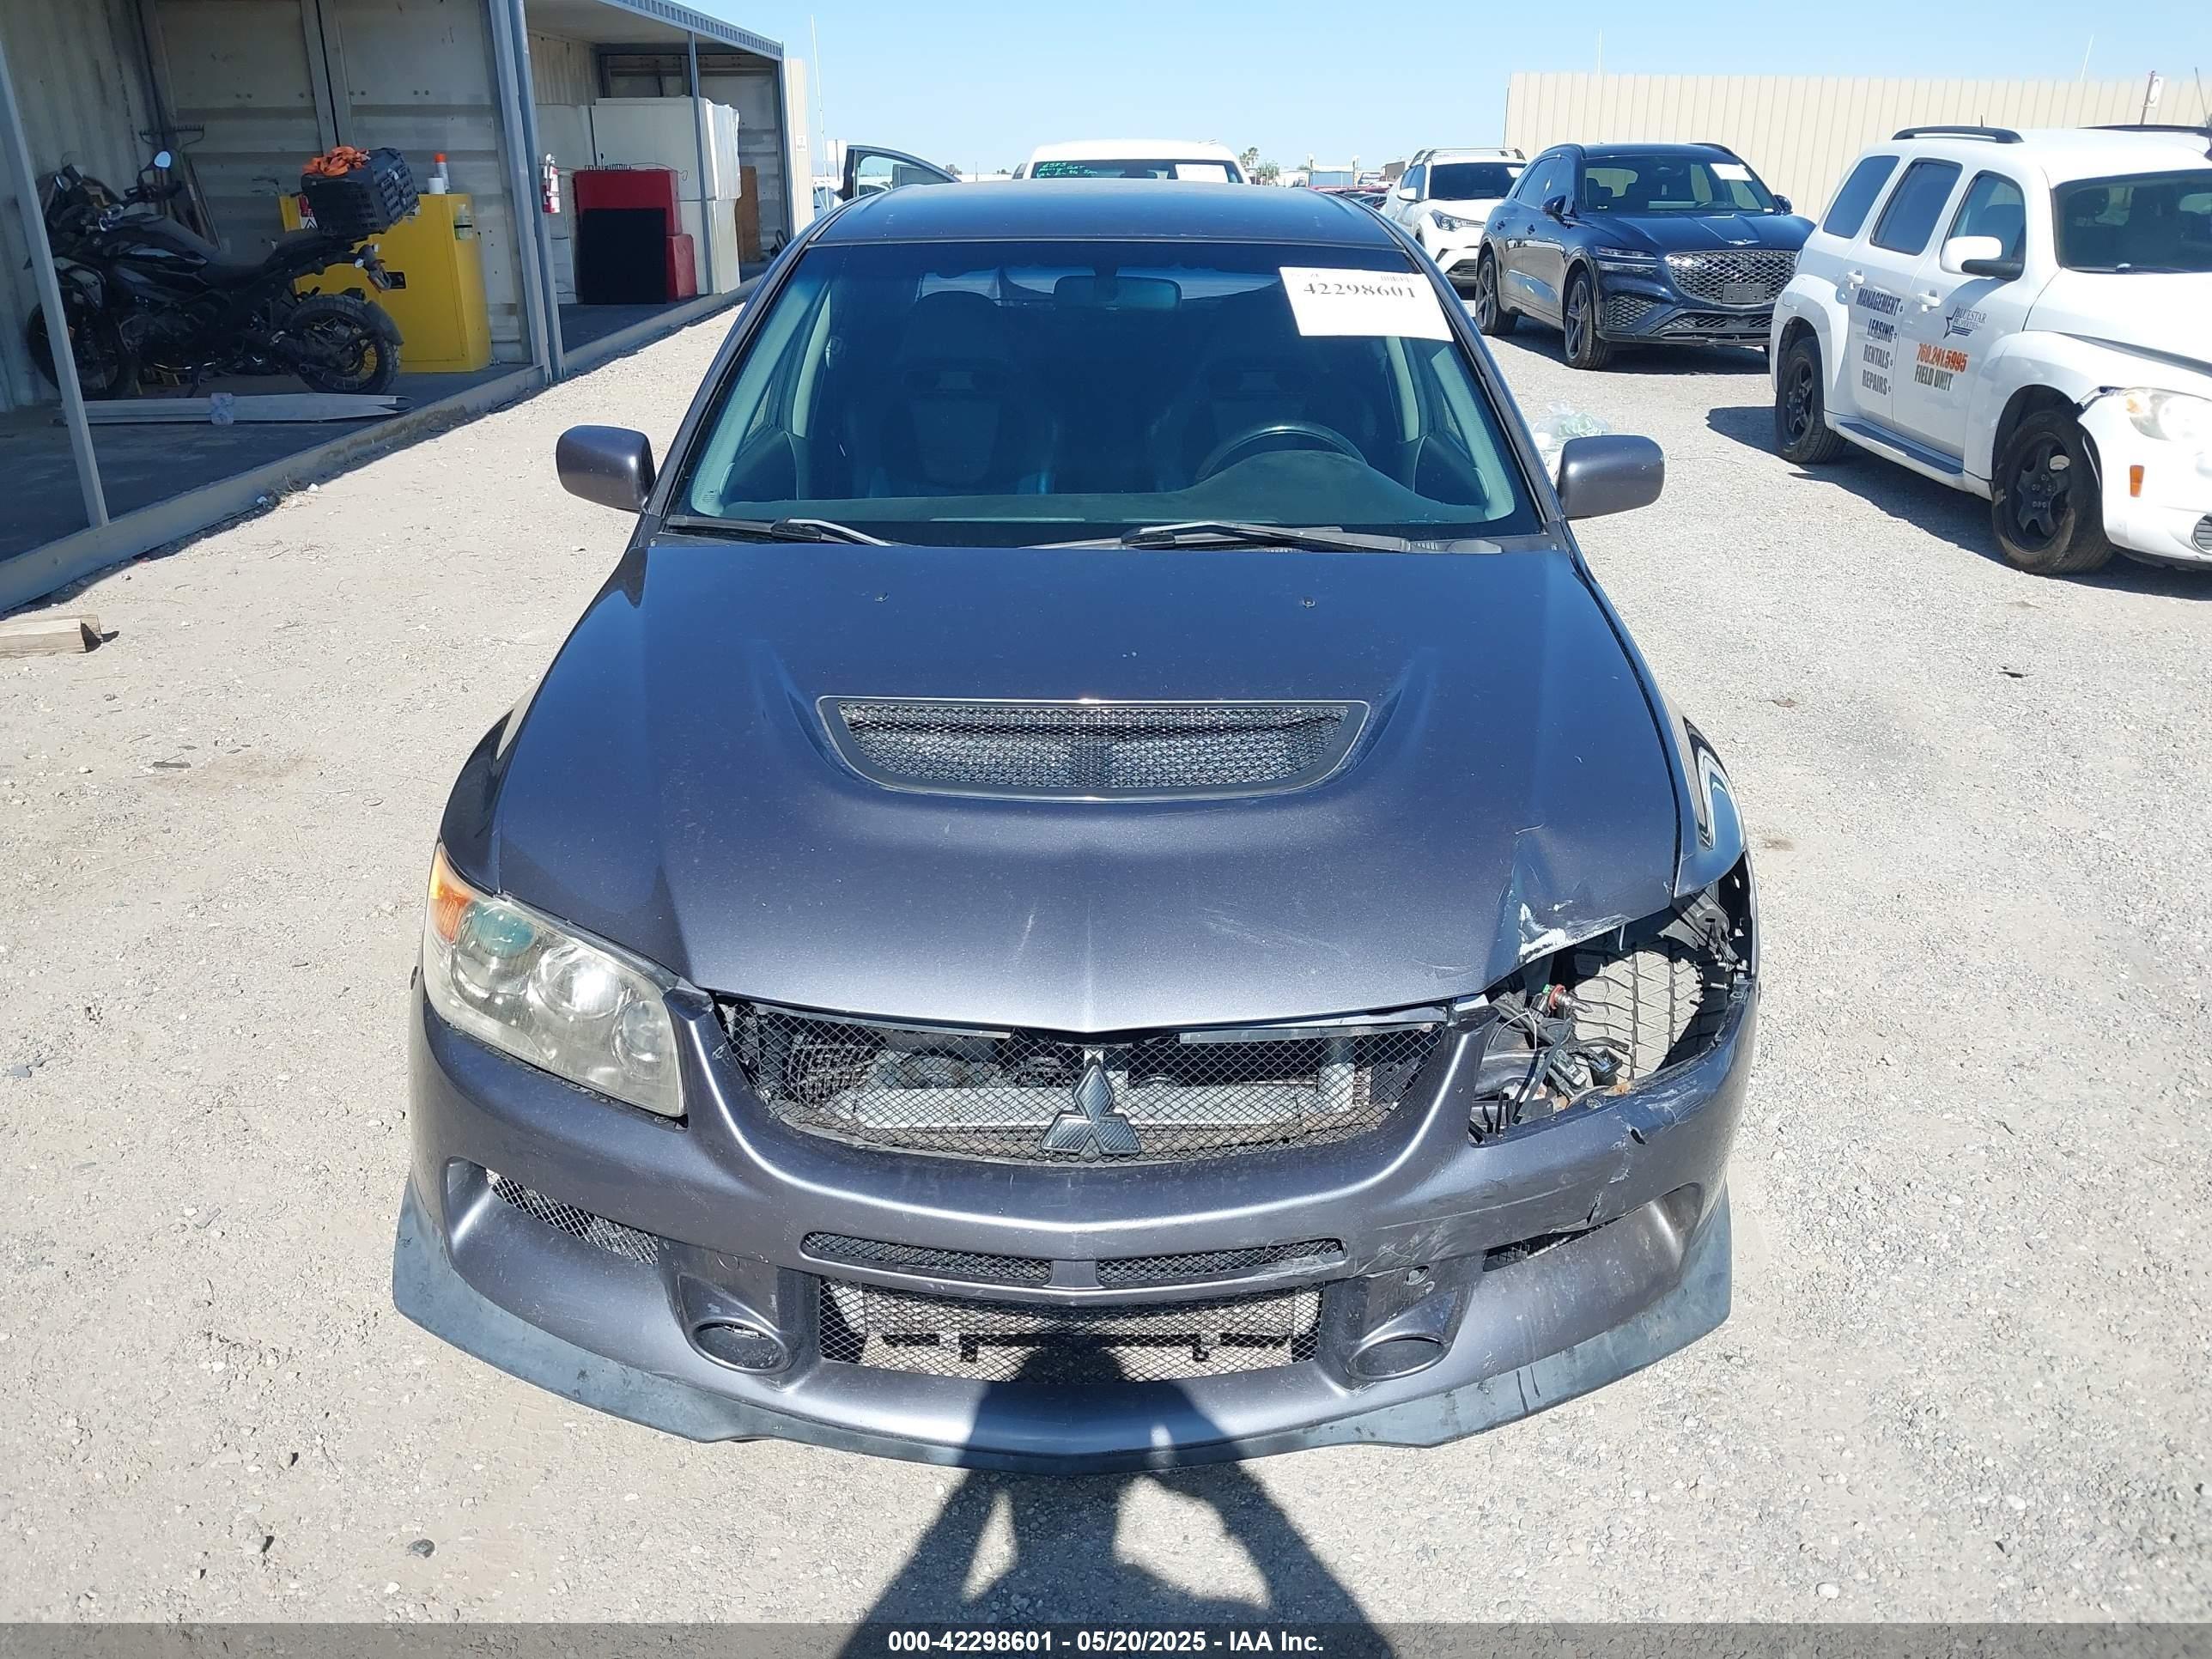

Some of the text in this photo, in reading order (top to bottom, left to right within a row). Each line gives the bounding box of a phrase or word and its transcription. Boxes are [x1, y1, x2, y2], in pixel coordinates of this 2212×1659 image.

[1304, 283, 1416, 299] 42298601
[1856, 287, 1901, 317] MANAGEMENT
[1867, 318, 1895, 343] LEASING
[1863, 343, 1890, 369] RENTALS
[1917, 343, 1968, 373] 760.241.5995
[1862, 368, 1887, 395] REPAIRS
[1915, 364, 1954, 391] FIELD UNIT
